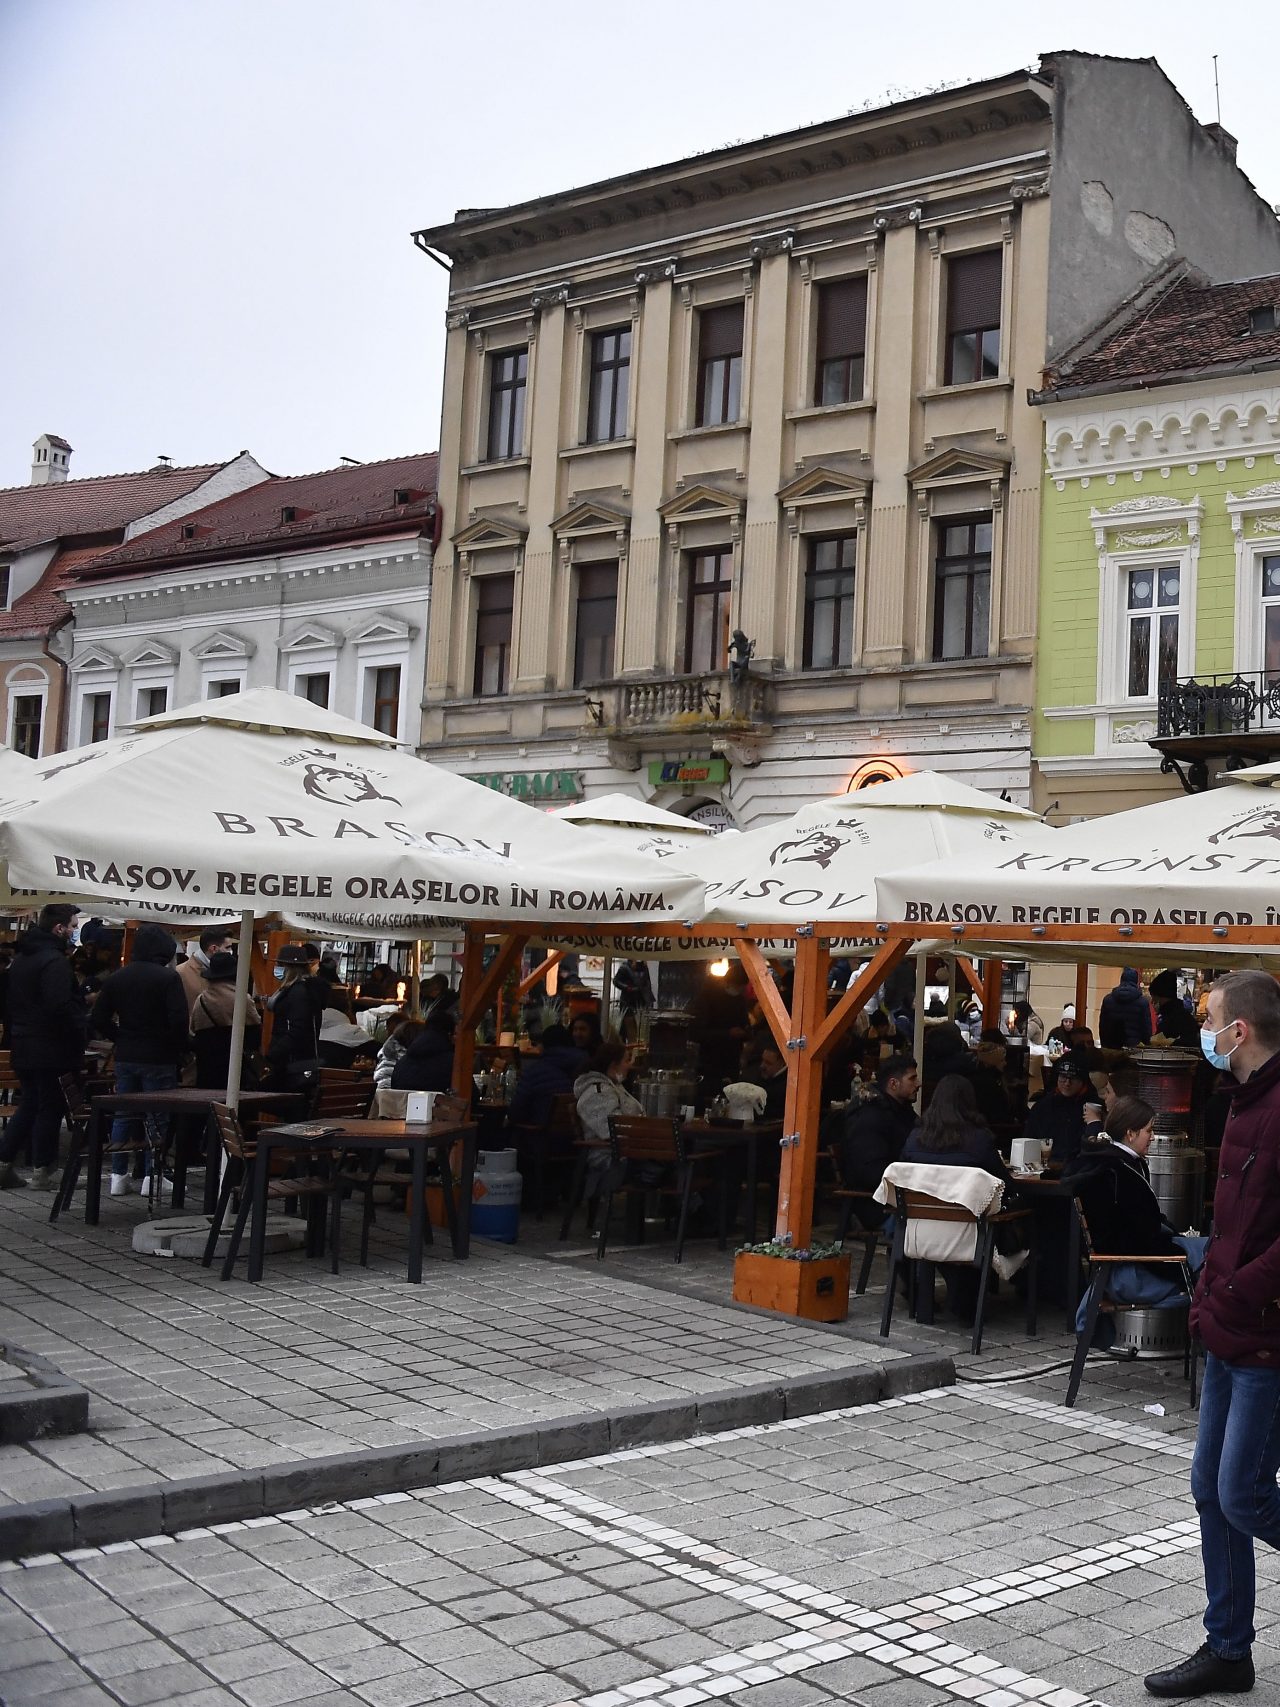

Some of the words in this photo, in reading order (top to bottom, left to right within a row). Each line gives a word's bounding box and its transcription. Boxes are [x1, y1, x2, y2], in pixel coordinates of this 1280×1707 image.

[53, 855, 200, 892] BRAȘOV.
[216, 871, 332, 898] REGELE
[345, 877, 500, 905] ORAȘELOR
[511, 882, 538, 909] ÎN
[549, 887, 675, 911] ROMÂNIA.
